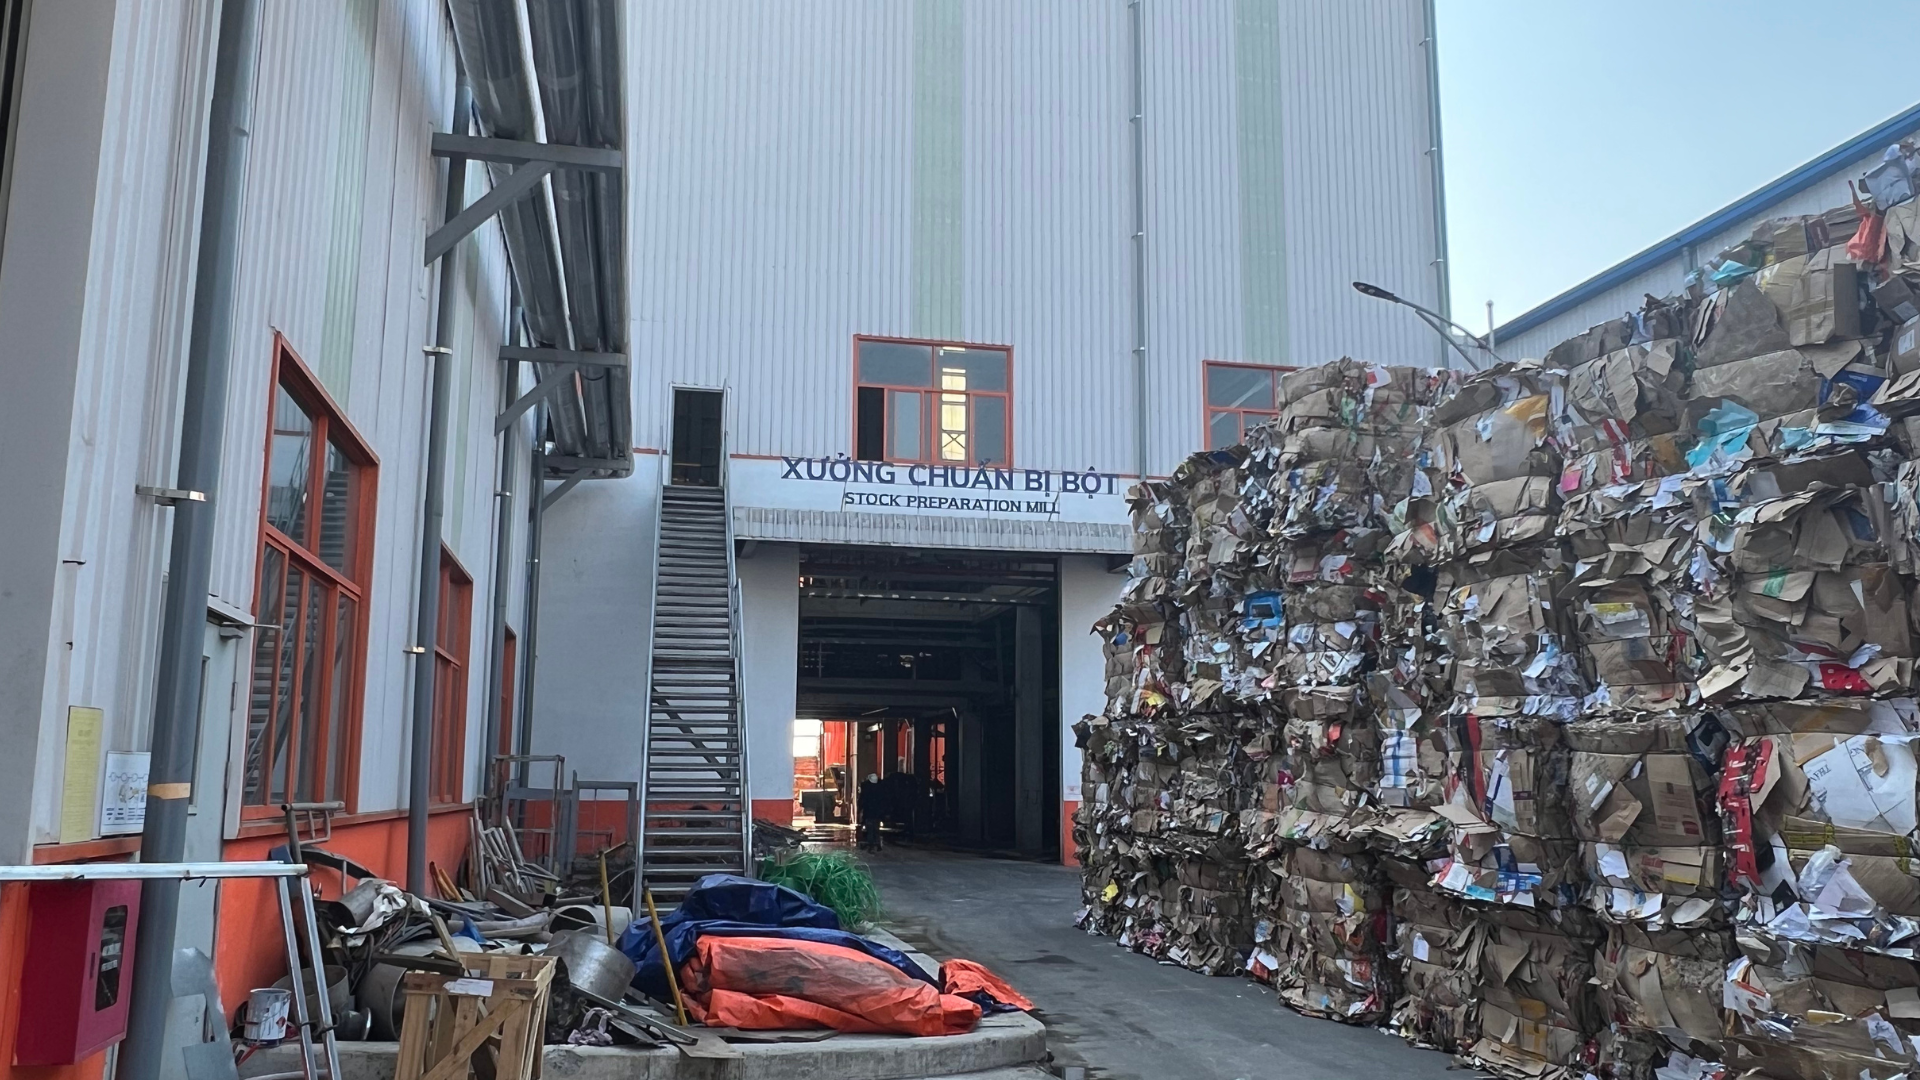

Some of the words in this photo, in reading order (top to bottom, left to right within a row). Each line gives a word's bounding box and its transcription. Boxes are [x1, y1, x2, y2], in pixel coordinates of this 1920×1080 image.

[781, 452, 896, 484] XƯỞNG
[908, 458, 1014, 490] CHUẨN
[1025, 469, 1051, 497] BỊ
[1062, 466, 1120, 499] BỘT
[844, 491, 902, 507] STOCK
[906, 495, 1021, 513] PREPARATION
[1026, 501, 1060, 514] MILL
